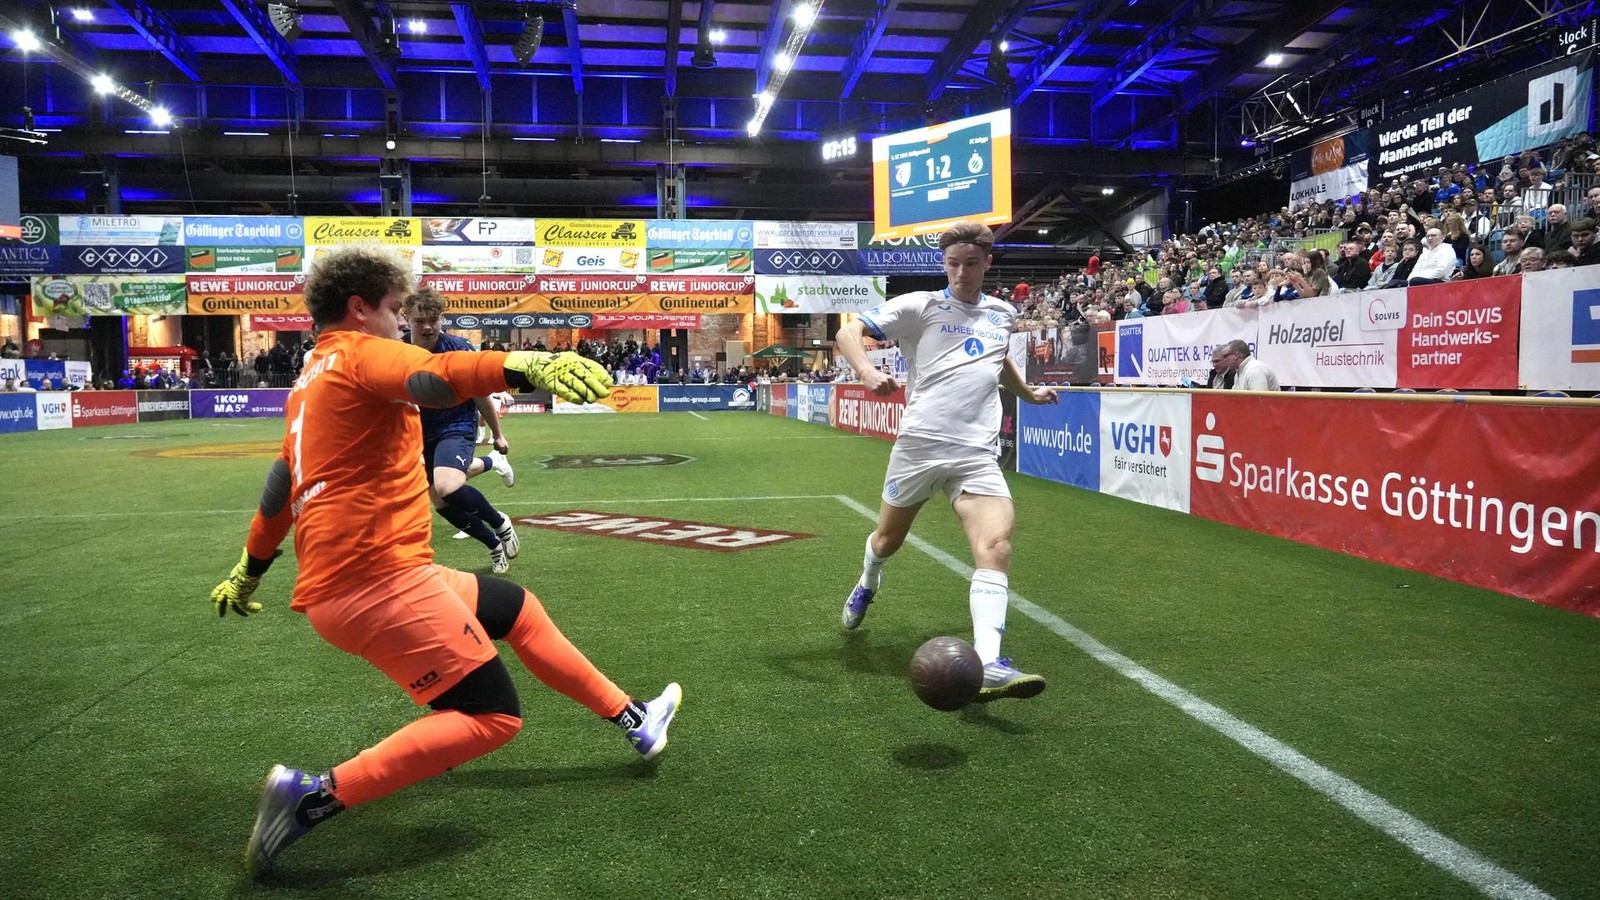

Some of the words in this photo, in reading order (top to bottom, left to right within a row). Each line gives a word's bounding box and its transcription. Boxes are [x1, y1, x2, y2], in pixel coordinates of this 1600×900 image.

[1361, 103, 1379, 119] Block
[1378, 124, 1418, 148] Werde
[1420, 111, 1446, 134] Teil
[1447, 105, 1473, 125] der
[822, 137, 857, 161] 07:15
[1378, 130, 1458, 166] Mannschaft.
[926, 154, 951, 181] 1:2
[1291, 183, 1326, 201] LOKHALLE
[186, 223, 234, 240] Göttinger
[235, 223, 280, 240] Tageblatt
[314, 223, 380, 240] Clausen
[544, 224, 607, 241] Clausen
[648, 227, 691, 242] Göttinger
[692, 227, 733, 242] Tageblatt
[577, 256, 605, 267] Geis
[883, 252, 943, 263] ROMANTIC
[190, 281, 230, 292] REWE
[233, 280, 296, 293] JUNIORCUP
[468, 280, 526, 292] JUNIORCUP
[540, 280, 577, 291] REWE
[580, 280, 637, 292] JUNIORCUP
[650, 281, 686, 292] REWE
[689, 281, 746, 293] JUNIORCUP
[798, 285, 868, 296] stadtwerke
[202, 296, 279, 312] Continental
[444, 297, 510, 310] ontinental
[550, 296, 621, 310] Continental
[659, 296, 729, 311] Continental
[831, 298, 868, 306] göttingen
[481, 318, 508, 326] Glinicke
[538, 317, 564, 326] Glinicke
[1375, 312, 1399, 321] SOLVIS
[1413, 312, 1442, 328] Dein
[1446, 306, 1502, 326] SOLVIS
[1120, 327, 1142, 337] QUATTEK
[1268, 320, 1344, 348] Holzapfel
[1412, 329, 1499, 347] Handwerks-
[1148, 346, 1189, 364] QUATTEK
[1193, 344, 1200, 362] &
[1316, 351, 1385, 366] Haustechnik
[1412, 351, 1462, 368] partner
[70, 374, 83, 382] VGH
[1147, 367, 1210, 381] Steuerberatungsg
[214, 394, 248, 403] 1KOM
[42, 403, 60, 414] VGH
[82, 406, 110, 418] Sparkasse
[111, 405, 136, 418] Göttingen
[839, 398, 858, 428] REWE
[859, 400, 904, 436] JUNIORCUP
[290, 400, 305, 487] 1
[1023, 423, 1092, 457] www.vgh.de
[1111, 422, 1155, 455] VGH
[1114, 456, 1127, 472] fair
[1128, 461, 1167, 478] versichert
[1229, 451, 1369, 511] Sparkasse
[1380, 471, 1600, 554] Göttingen
[519, 512, 791, 548] REWE
[464, 623, 482, 645] 1
